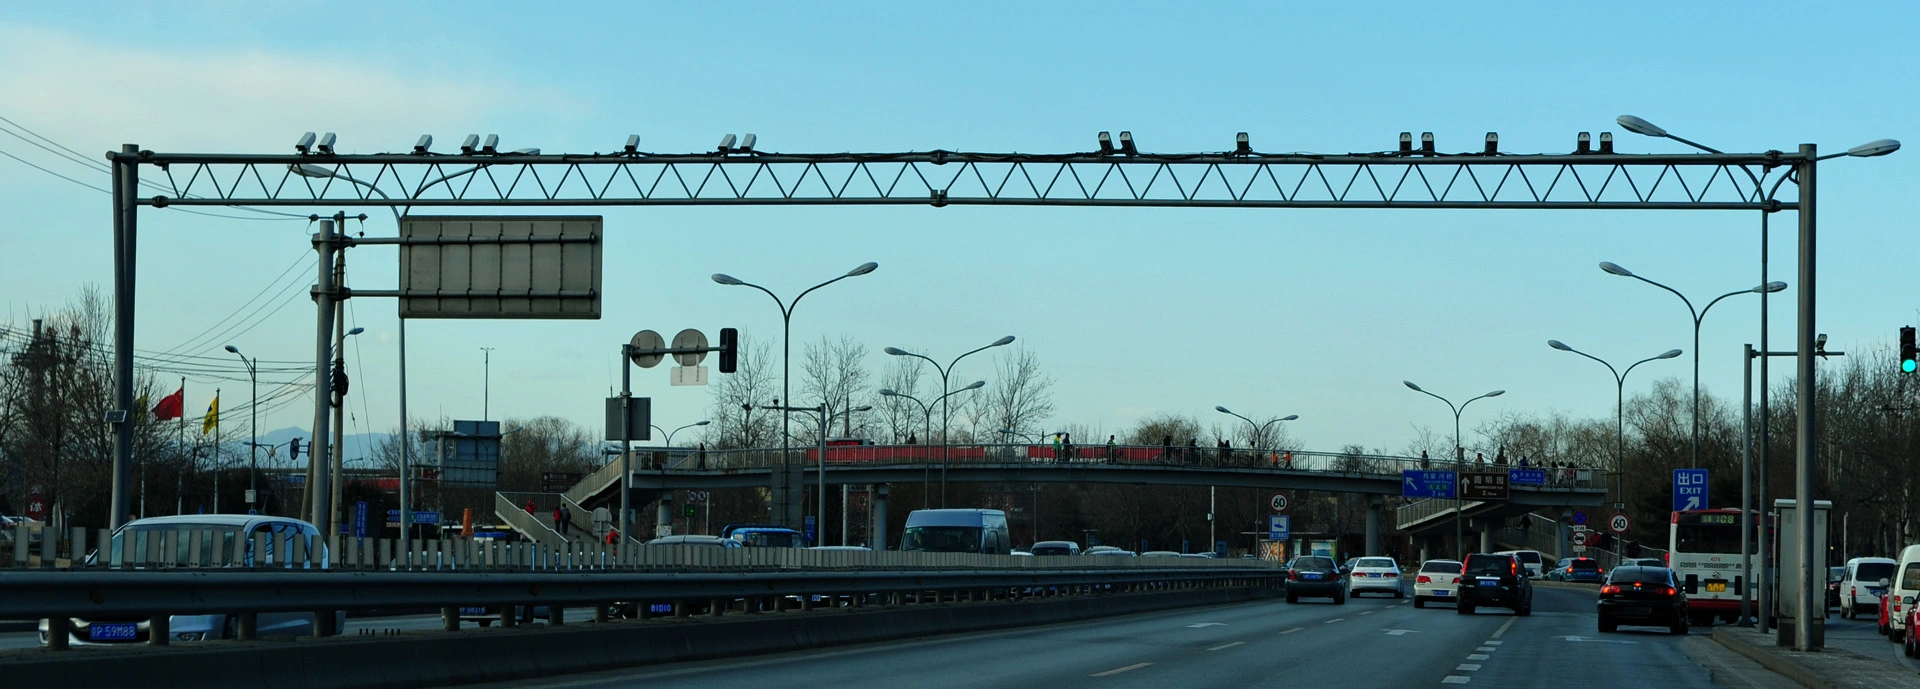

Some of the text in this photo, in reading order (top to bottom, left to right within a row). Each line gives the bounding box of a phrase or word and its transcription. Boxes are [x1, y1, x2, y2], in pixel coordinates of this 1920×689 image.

[1677, 472, 1704, 486] 出口
[1680, 487, 1703, 495] EXIT
[1273, 498, 1286, 508] 60
[1613, 519, 1626, 529] 60
[105, 626, 136, 637] 59M88
